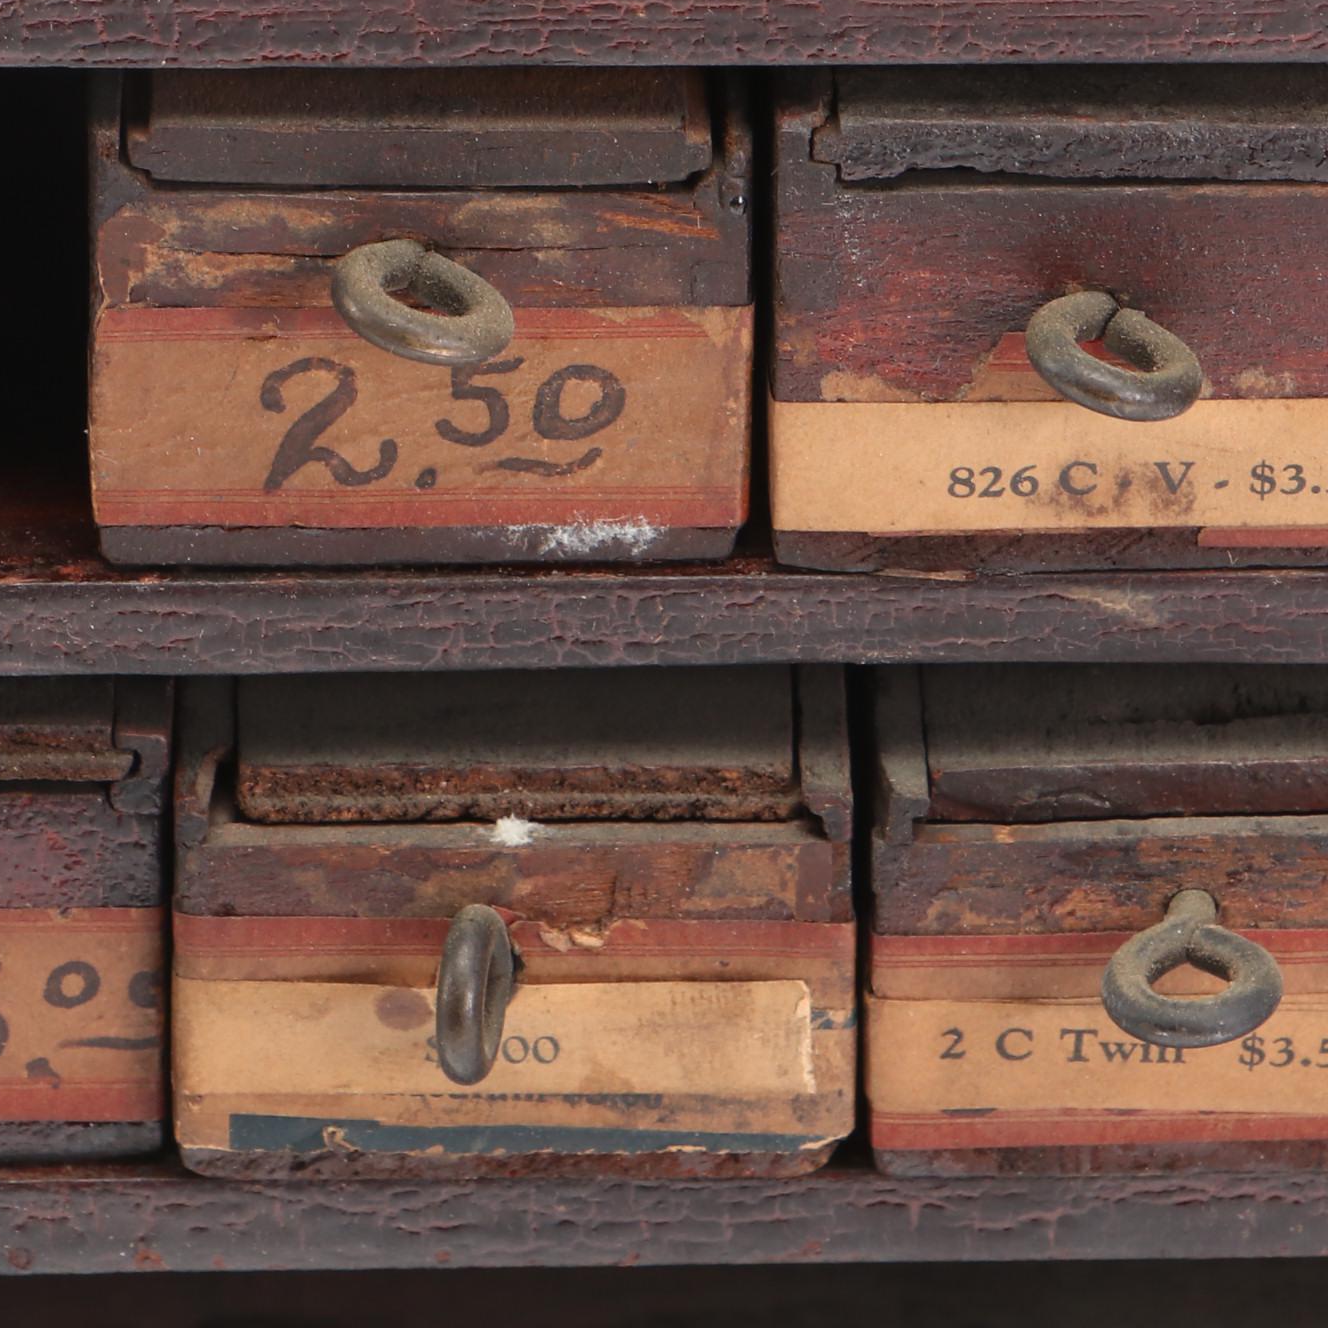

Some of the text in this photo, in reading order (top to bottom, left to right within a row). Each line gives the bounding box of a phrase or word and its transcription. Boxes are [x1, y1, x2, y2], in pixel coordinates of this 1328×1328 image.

[260, 356, 627, 494] 2.50
[947, 465, 1040, 499] 826
[1058, 460, 1099, 495] C
[1153, 461, 1196, 495] V
[939, 1028, 966, 1061] 2
[994, 1028, 1034, 1061] C
